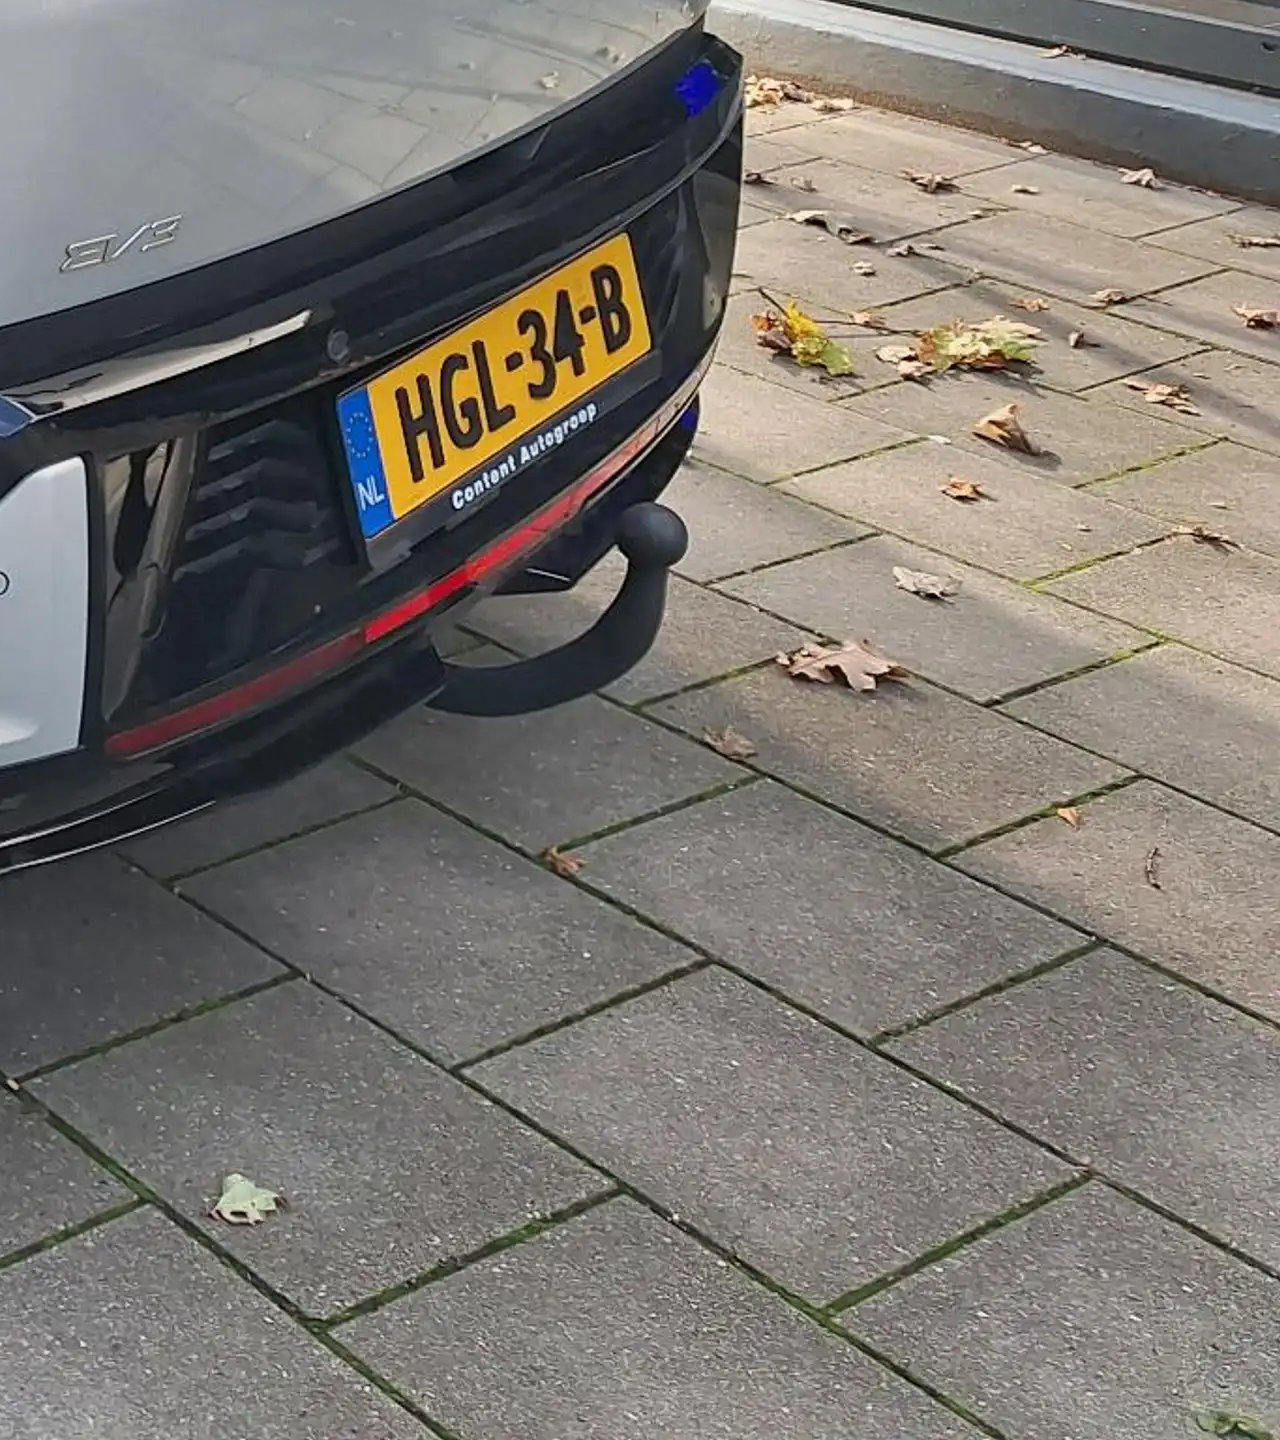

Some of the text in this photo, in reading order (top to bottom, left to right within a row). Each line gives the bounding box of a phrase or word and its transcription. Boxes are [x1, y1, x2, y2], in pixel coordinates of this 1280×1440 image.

[395, 264, 632, 483] HGL-34-B
[355, 474, 385, 511] NL
[451, 402, 597, 510] Content Autogroep
